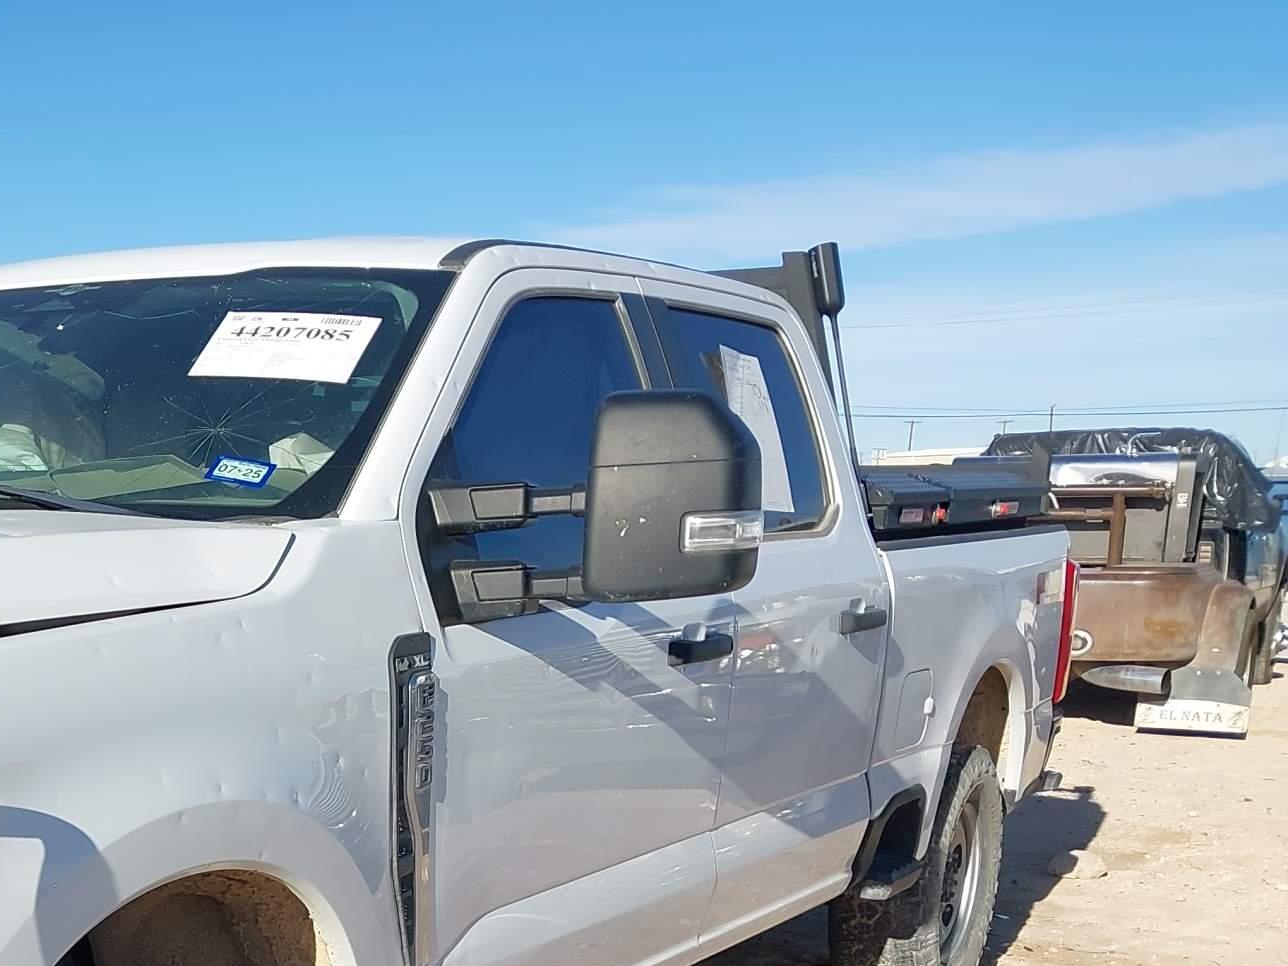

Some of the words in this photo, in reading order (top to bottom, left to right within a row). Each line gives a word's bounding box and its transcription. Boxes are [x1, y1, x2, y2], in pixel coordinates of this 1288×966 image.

[231, 325, 353, 343] 44207085
[413, 655, 429, 667] XL
[1159, 709, 1177, 721] EL
[1180, 711, 1223, 723] NATA
